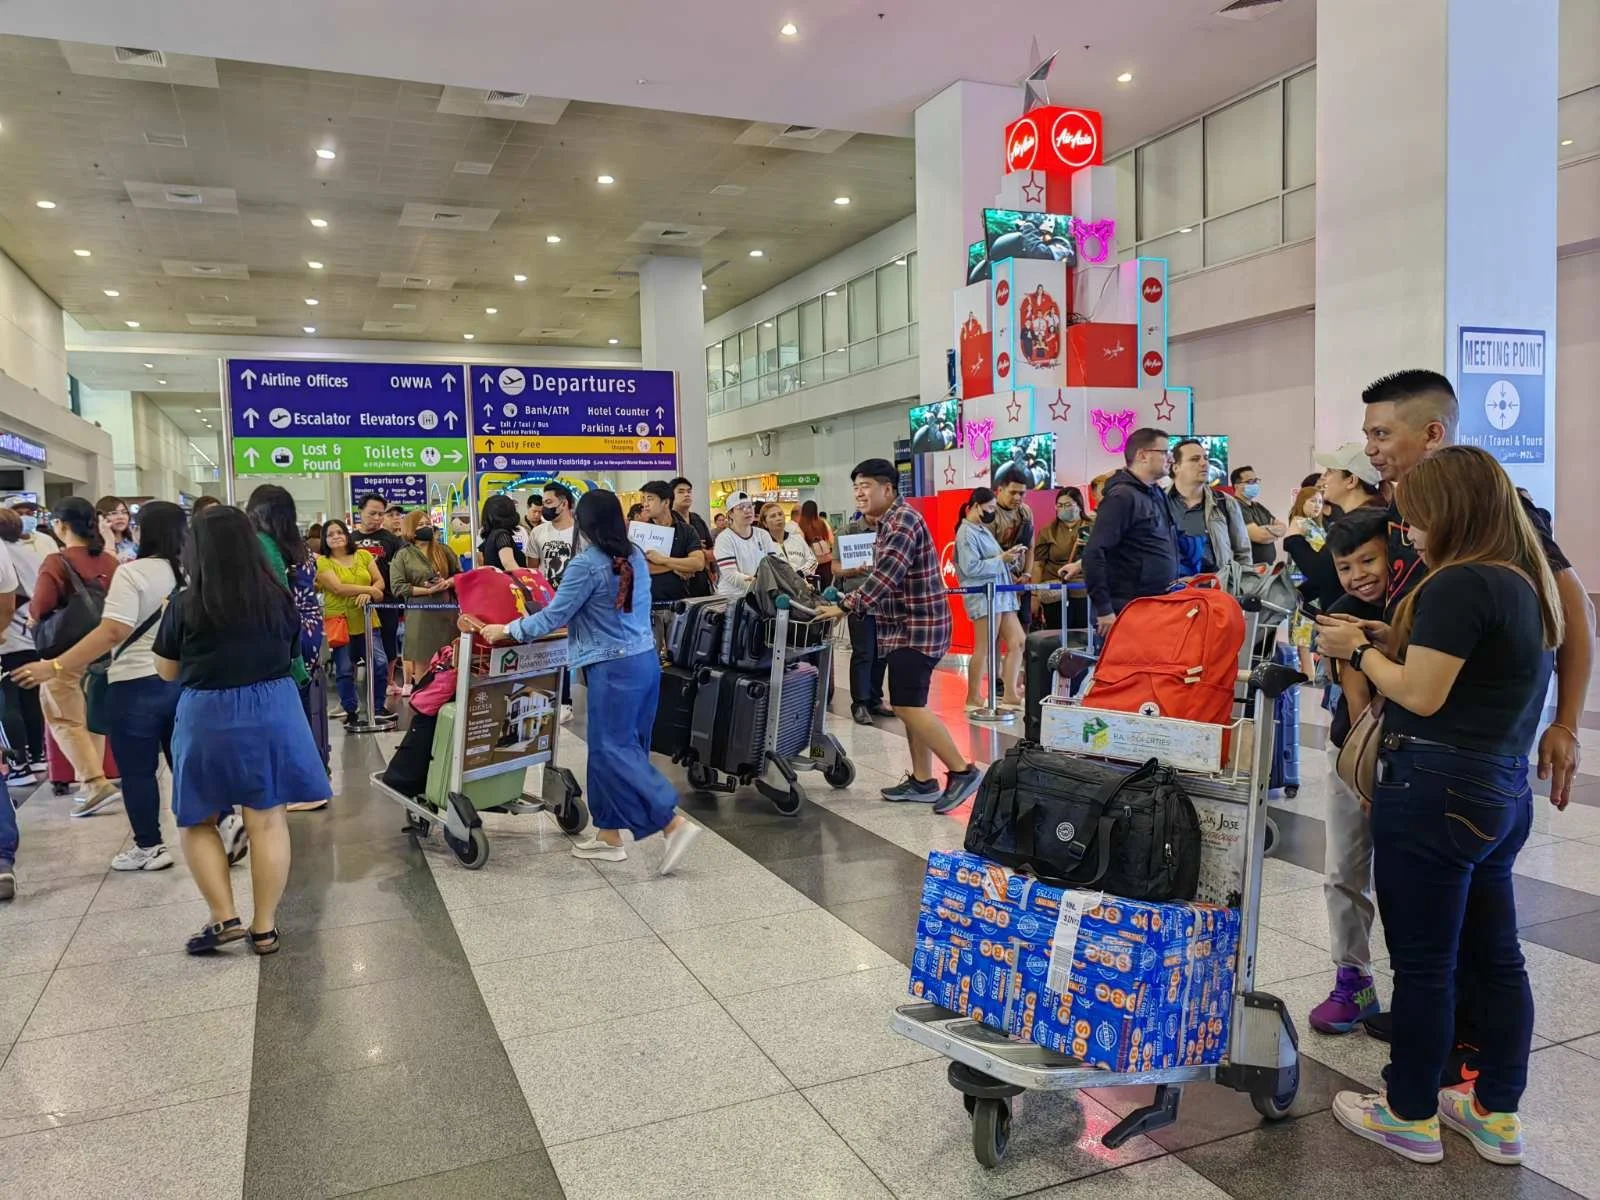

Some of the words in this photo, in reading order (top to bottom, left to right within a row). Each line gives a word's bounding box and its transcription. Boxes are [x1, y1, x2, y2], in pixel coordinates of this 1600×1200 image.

[1465, 339, 1510, 367] MEETING
[1512, 342, 1542, 369] POINT
[261, 372, 301, 388] Airline
[306, 374, 349, 389] Offices
[390, 376, 432, 389] OWWA
[533, 374, 636, 396] Departures
[525, 405, 570, 416] Bank/ATM
[587, 406, 612, 416] Hotel
[615, 407, 650, 417] Counter
[294, 412, 351, 425] Escalator
[359, 413, 416, 426] Elevators
[581, 423, 615, 435] Parking
[618, 424, 633, 433] A-E
[302, 443, 327, 456] Lost
[333, 444, 342, 456] &
[363, 445, 414, 459] Toilets
[500, 441, 519, 450] Duty
[303, 457, 342, 471] Found
[364, 477, 404, 486] Departures
